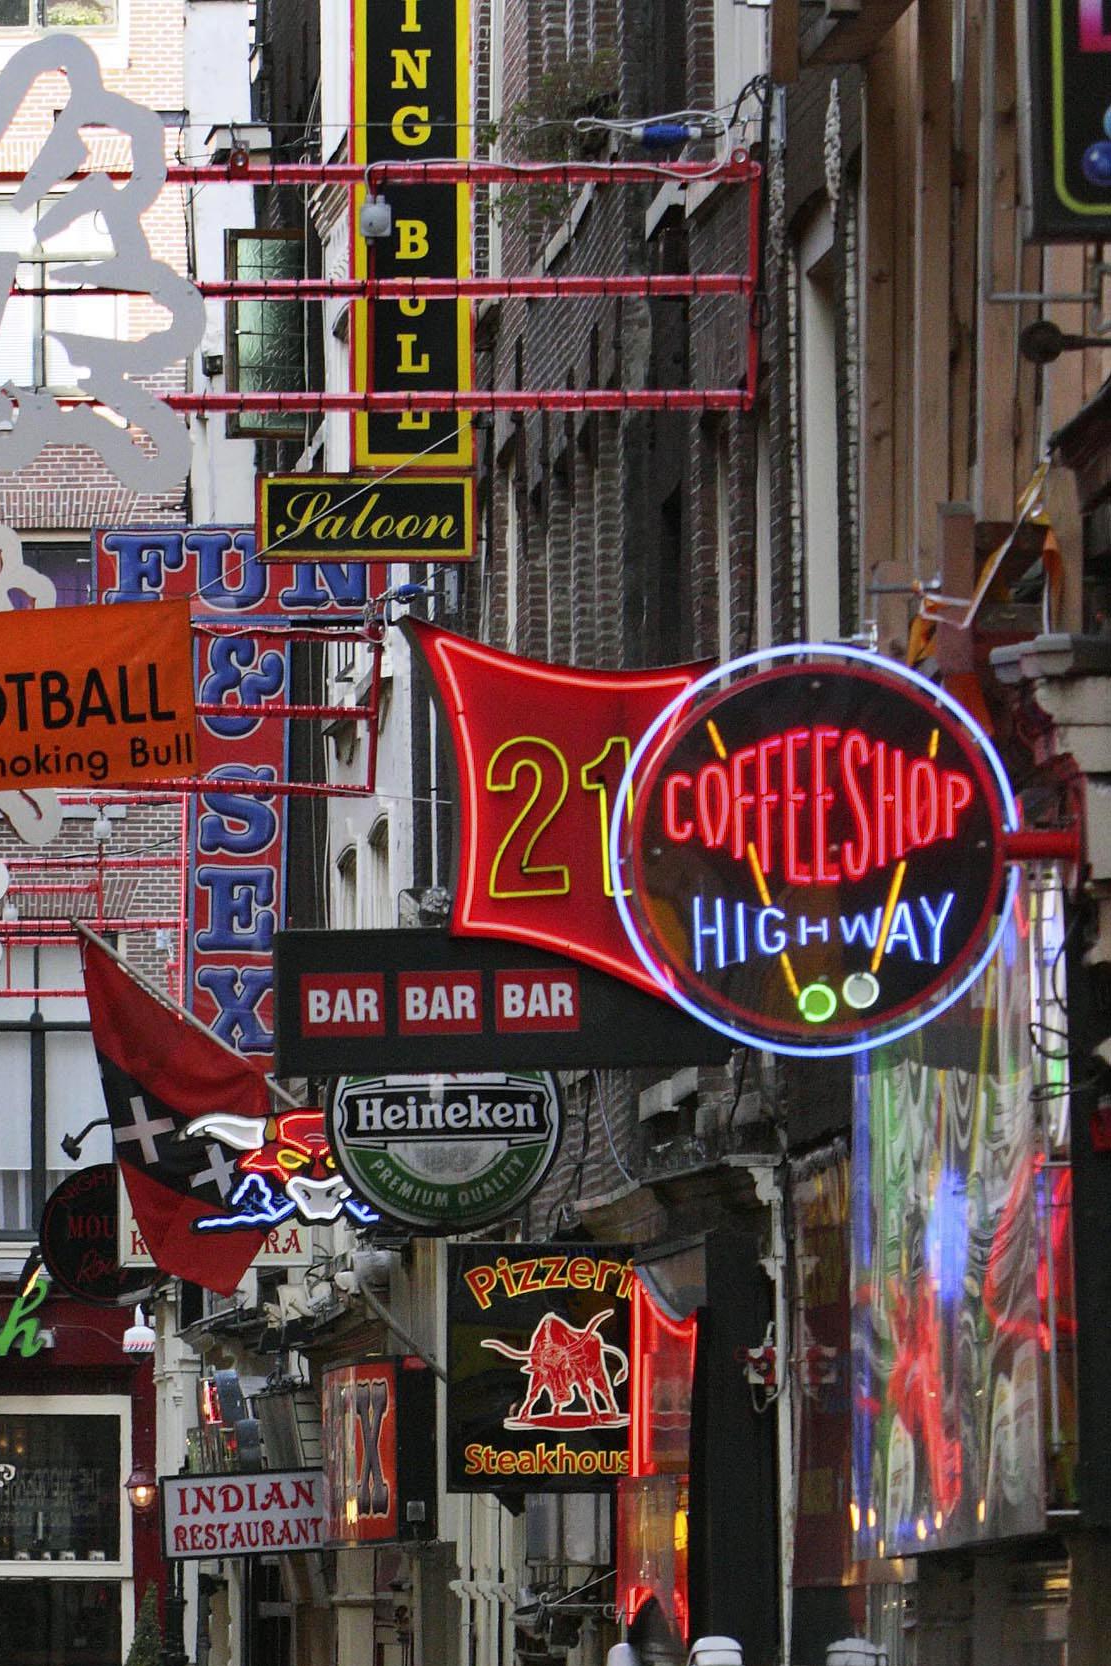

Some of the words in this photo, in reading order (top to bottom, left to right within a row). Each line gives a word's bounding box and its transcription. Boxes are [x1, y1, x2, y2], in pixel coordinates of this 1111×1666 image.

[276, 491, 458, 540] Saloon
[102, 533, 369, 608] FUN
[130, 733, 194, 768] Bull
[486, 736, 633, 898] 21
[663, 723, 974, 886] COFFEESHOP
[196, 765, 277, 1054] SEX
[693, 892, 955, 974] HIGHWAY
[308, 988, 379, 1024] BAR
[405, 985, 476, 1021] BAR
[502, 982, 574, 1018] BAR
[355, 1094, 538, 1132] Heineken
[368, 1157, 450, 1207] PREMIUM
[457, 1153, 526, 1206] QUALITY
[464, 1255, 636, 1310] Pizzeri
[464, 1442, 630, 1475] Steakhous
[178, 1479, 316, 1516] INDIAN
[173, 1517, 324, 1552] RESTAURANT
